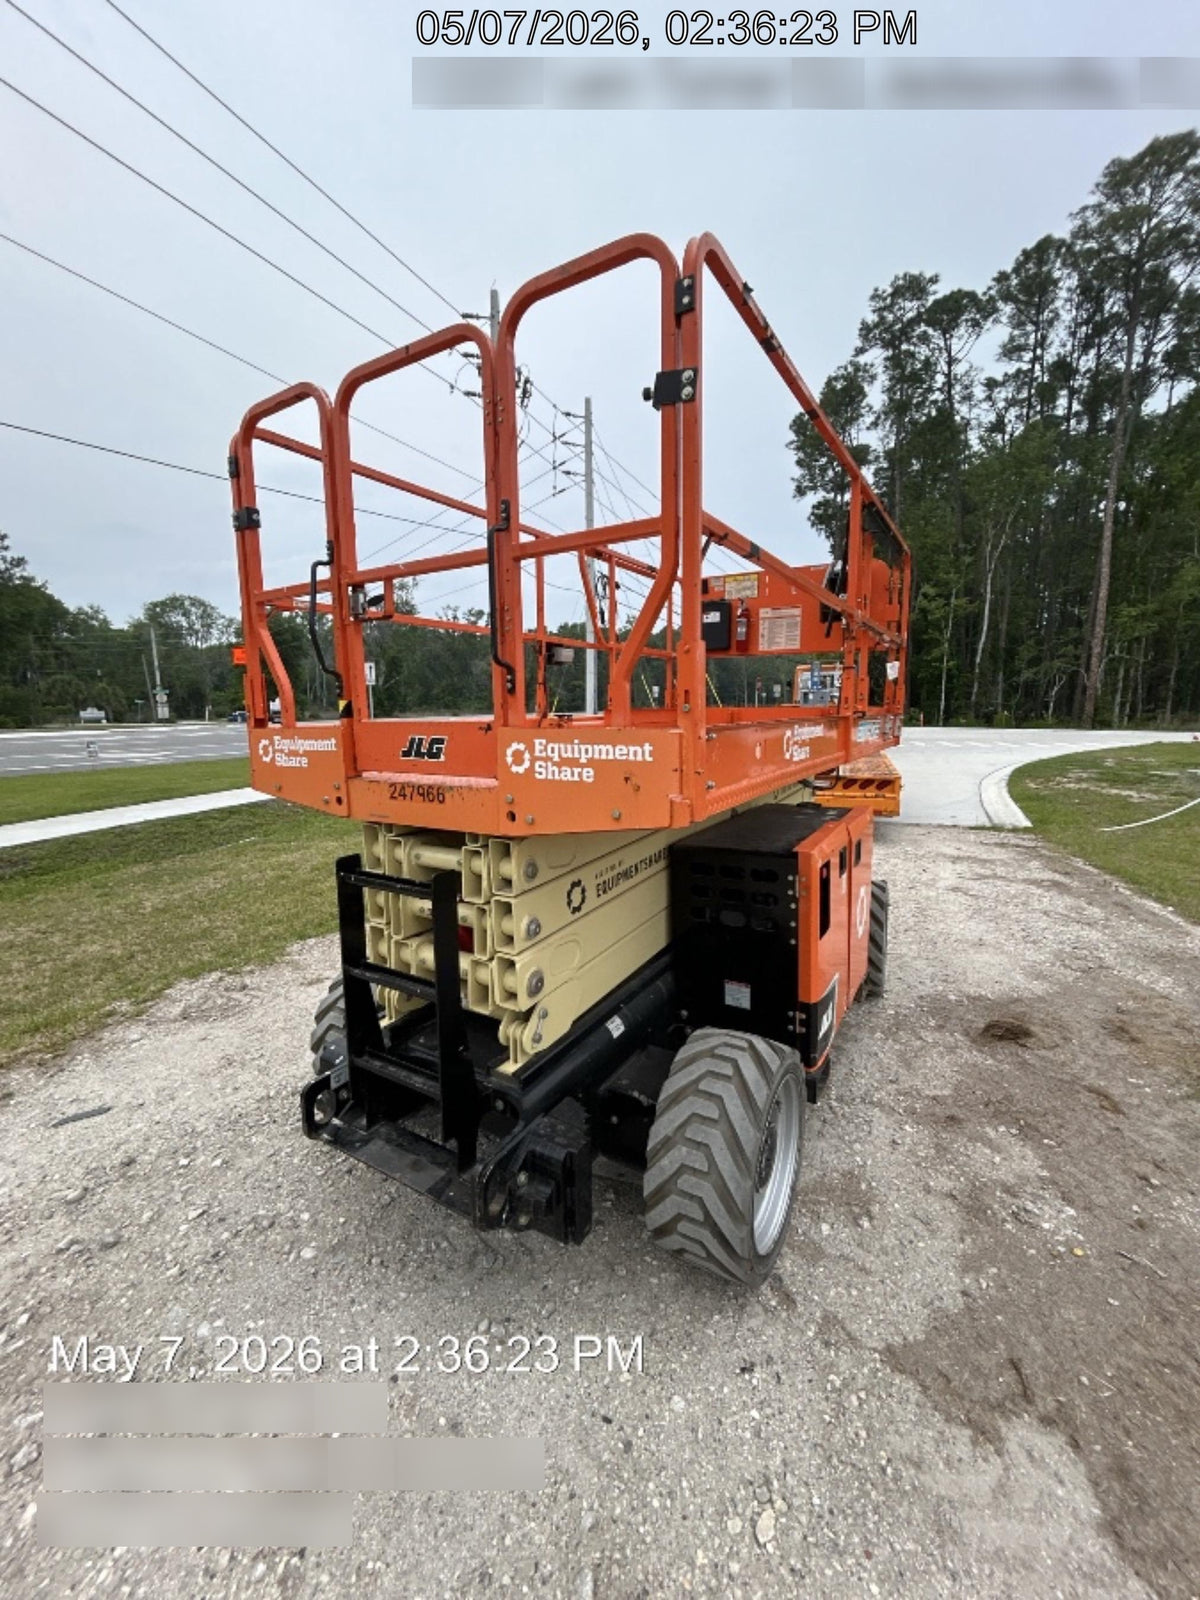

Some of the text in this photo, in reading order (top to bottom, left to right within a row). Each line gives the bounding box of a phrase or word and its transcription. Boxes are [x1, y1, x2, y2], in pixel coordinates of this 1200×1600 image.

[273, 735, 337, 754] Equipment
[400, 735, 447, 761] JLG
[534, 738, 653, 763] Equipment
[274, 752, 308, 767] Share
[534, 760, 594, 782] Share
[389, 781, 446, 804] 247966
